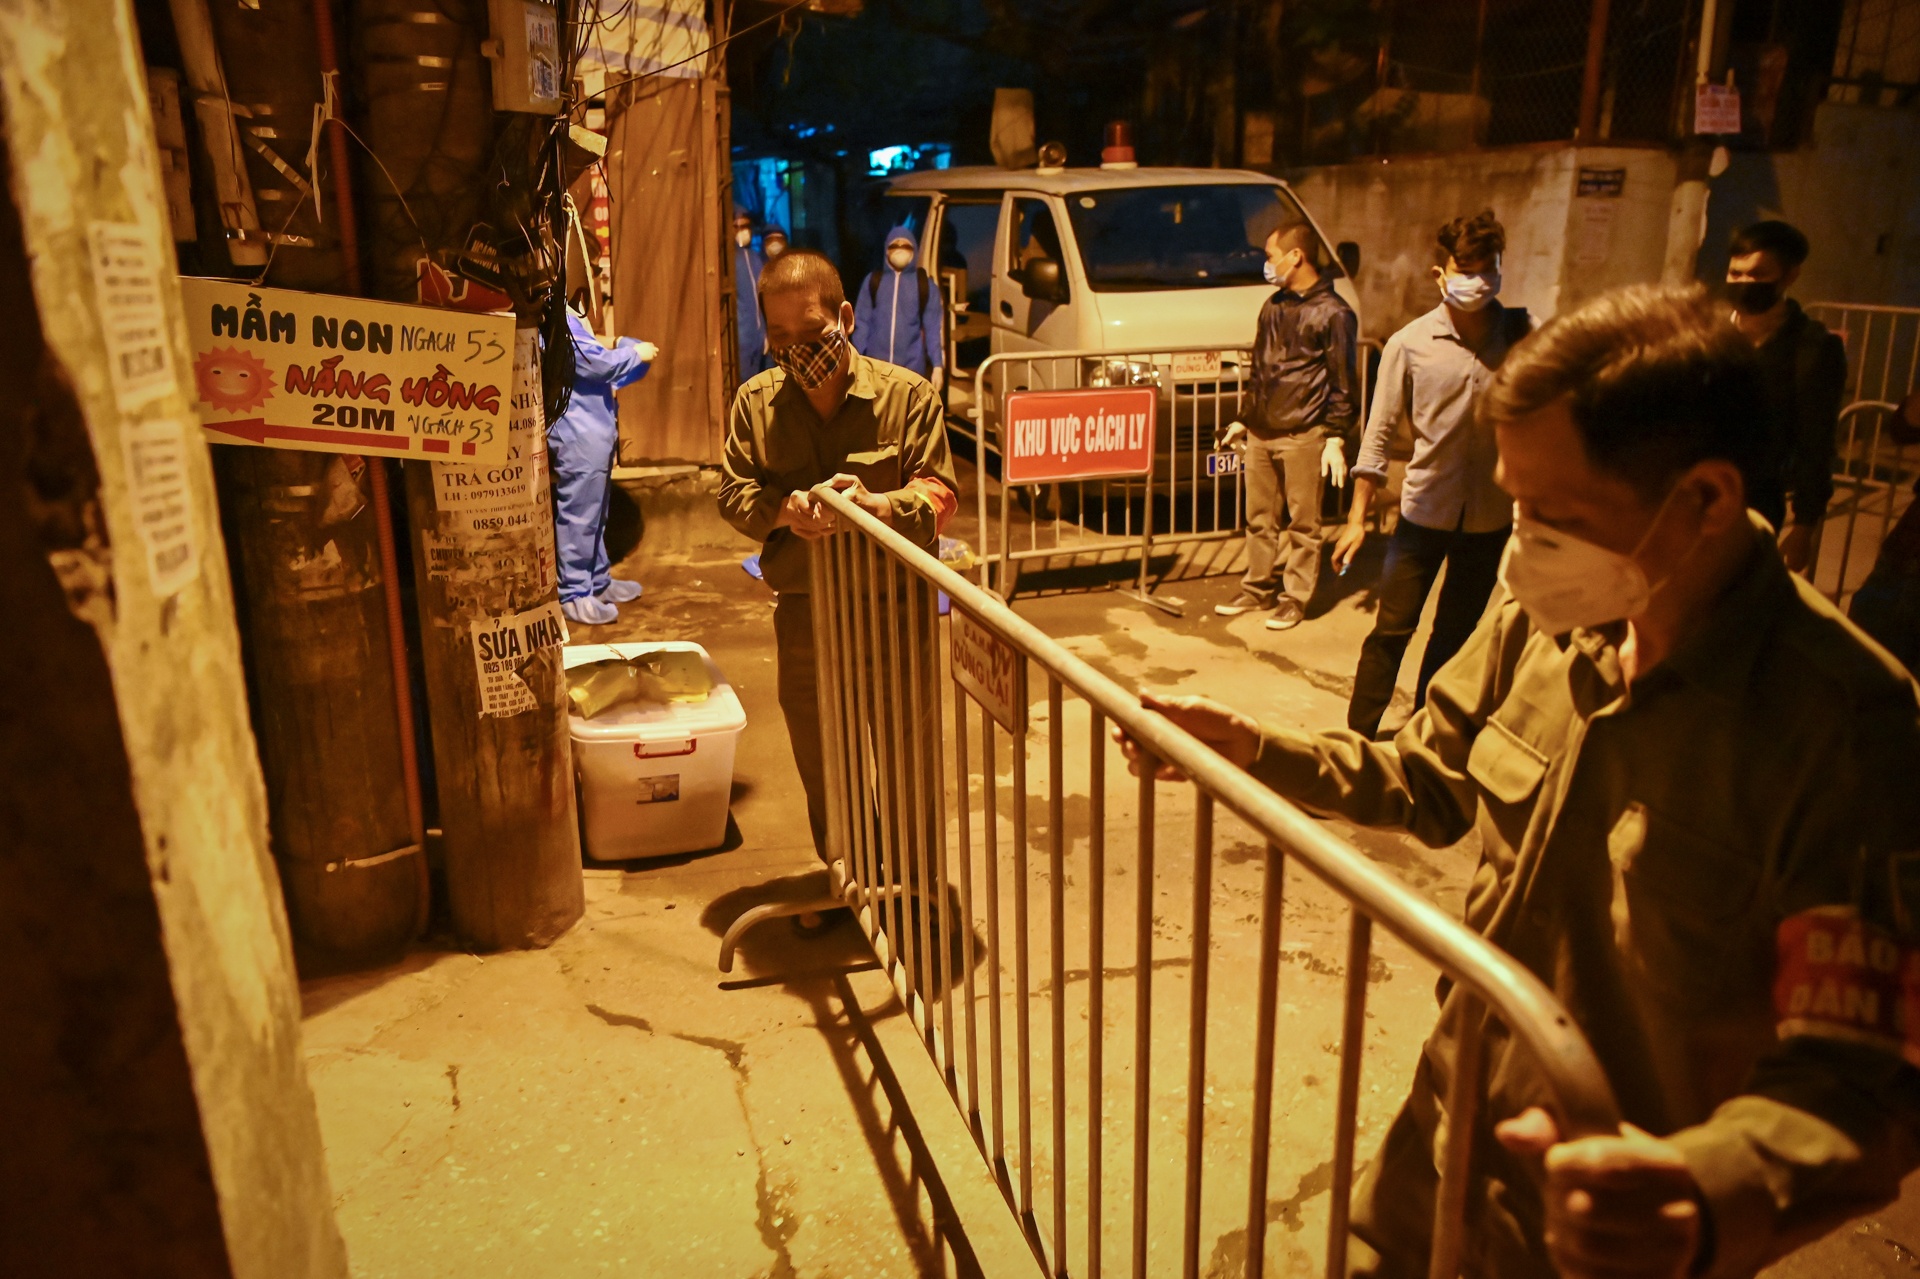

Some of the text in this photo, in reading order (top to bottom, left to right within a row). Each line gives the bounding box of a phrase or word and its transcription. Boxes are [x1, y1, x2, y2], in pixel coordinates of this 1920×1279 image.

[211, 292, 394, 355] MẦM NON
[284, 355, 392, 405] NẮNG
[400, 363, 501, 416] HỒNG
[312, 403, 395, 432] 20M
[465, 419, 494, 445] 53
[1014, 408, 1146, 463] KHU VỰC CÁCH LY
[487, 464, 523, 484] GÓP
[470, 484, 526, 500] 0979133619
[478, 609, 564, 661] SỬA NHÀ
[483, 660, 500, 674] 0925
[501, 658, 513, 672] 189
